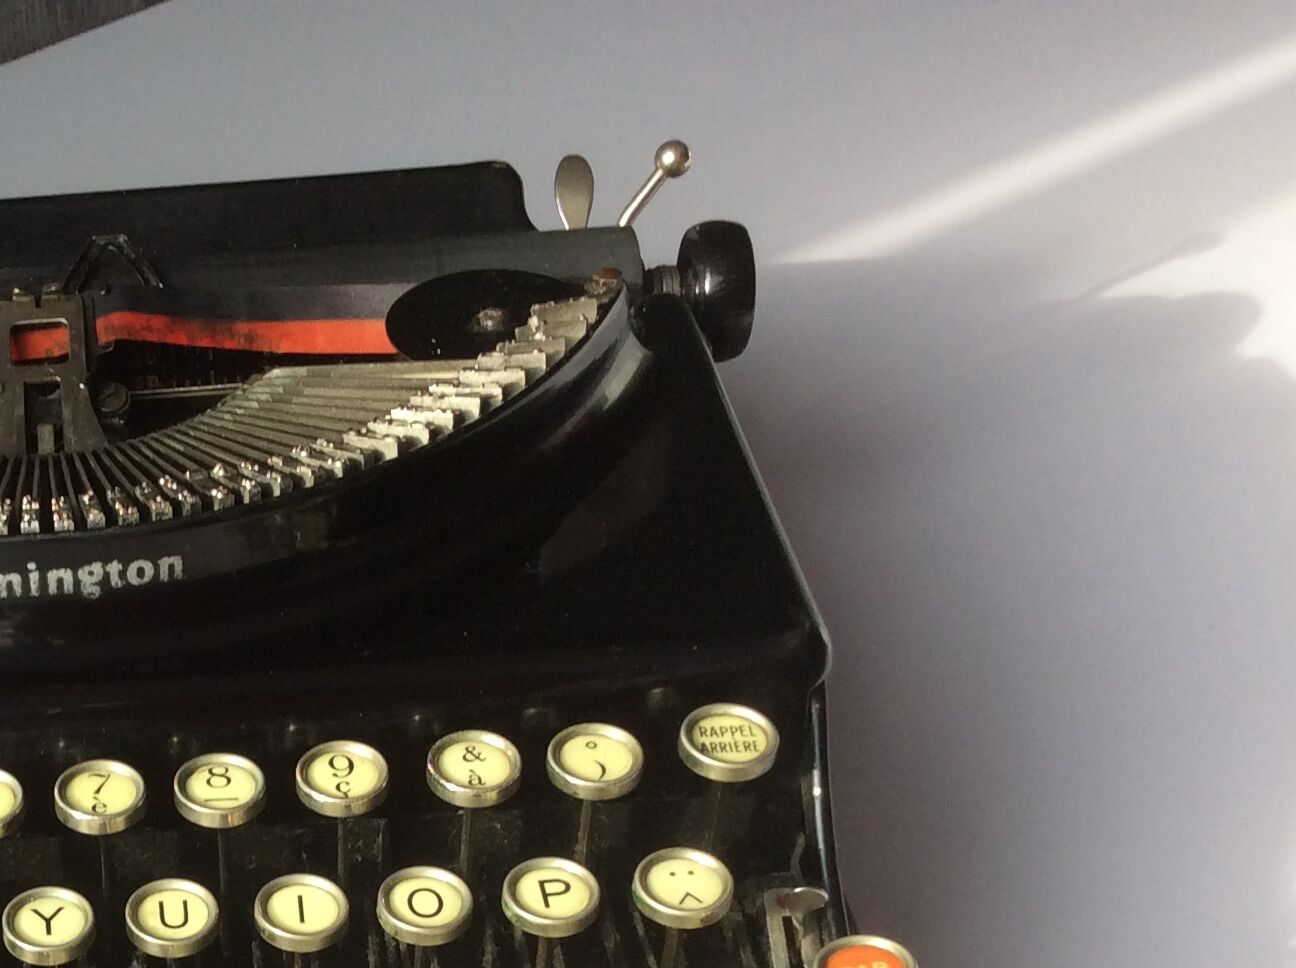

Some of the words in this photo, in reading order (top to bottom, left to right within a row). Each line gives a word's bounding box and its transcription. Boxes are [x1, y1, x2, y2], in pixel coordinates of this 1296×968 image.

[698, 724, 757, 738] RAPPEL
[328, 754, 354, 778] 9
[462, 745, 486, 763] &
[88, 773, 111, 795] 7
[206, 766, 231, 788] 8
[407, 888, 444, 918] O
[537, 878, 572, 908] P
[30, 906, 65, 936] Y
[158, 899, 189, 929] U
[297, 894, 306, 924] I
